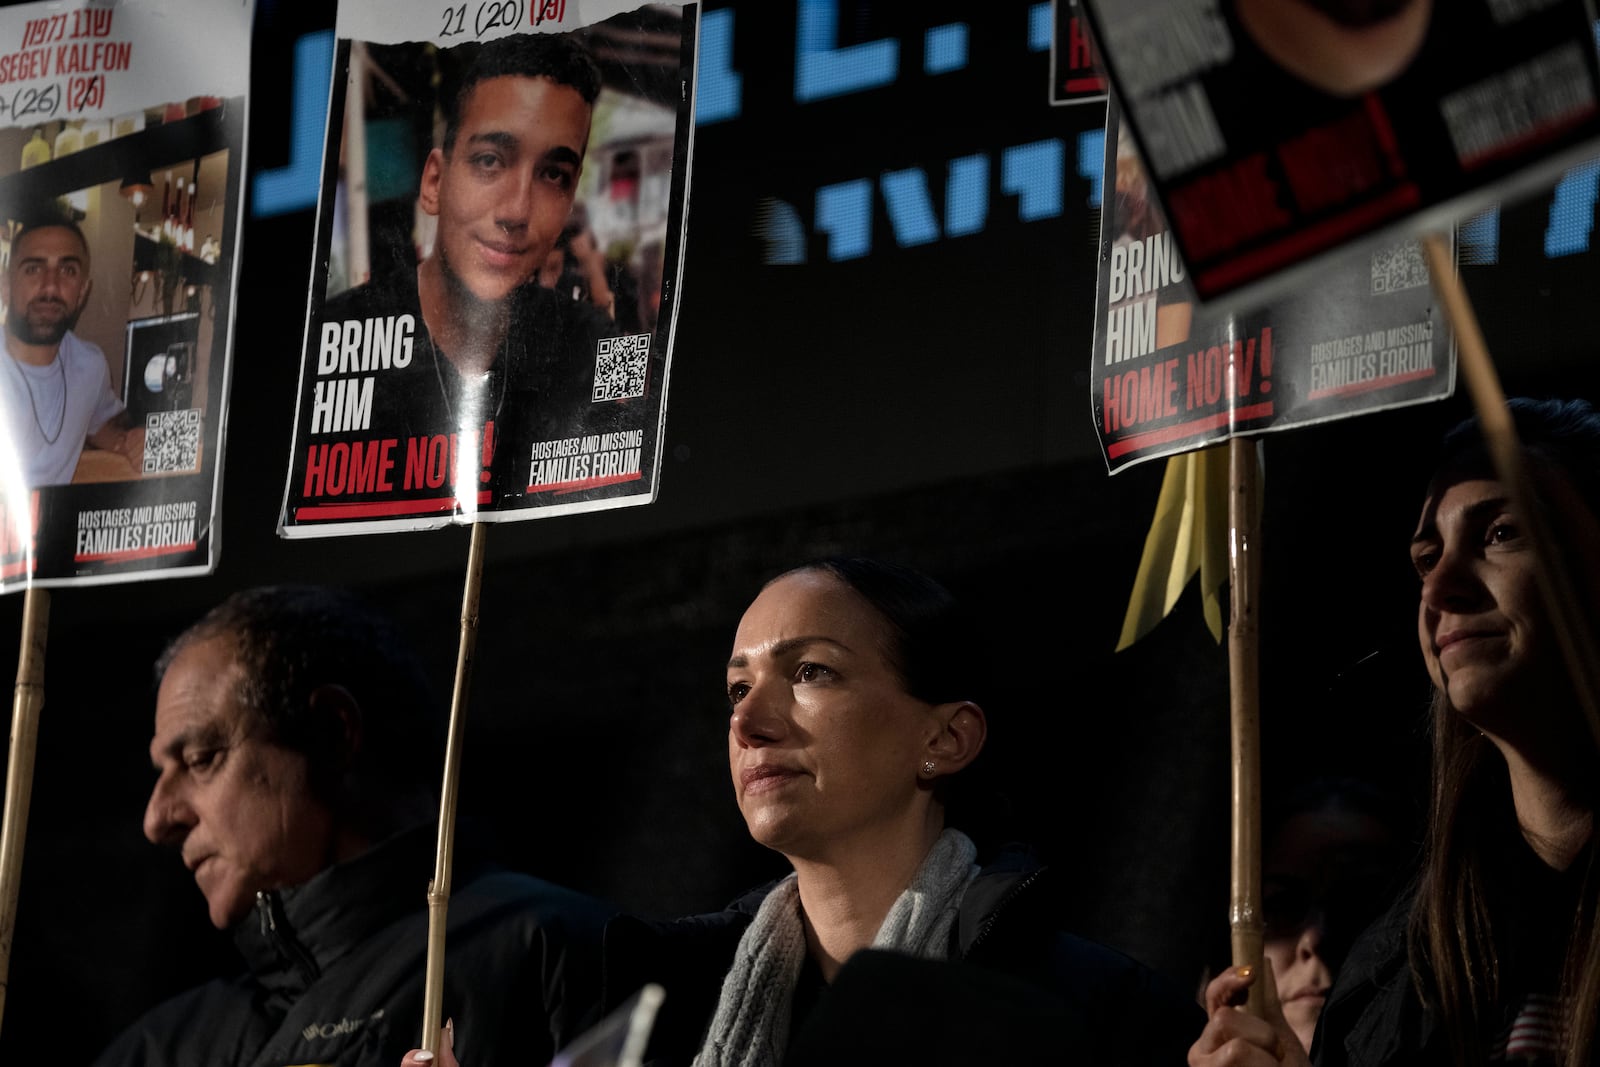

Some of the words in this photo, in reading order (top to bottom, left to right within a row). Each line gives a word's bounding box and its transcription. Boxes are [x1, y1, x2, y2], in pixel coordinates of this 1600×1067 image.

[21, 13, 68, 50] כלפון
[69, 8, 113, 39] שגב
[439, 3, 467, 37] 21
[475, 0, 524, 39] (20)
[0, 46, 51, 85] SEGEV
[55, 42, 131, 75] KALFON
[317, 313, 415, 375] BRING
[1104, 298, 1157, 366] HIM
[1311, 335, 1363, 365] HOSTAGES
[1364, 330, 1386, 353] AND
[1311, 353, 1377, 392] FAMILIES
[1379, 341, 1433, 378] FORUM
[310, 377, 375, 435] HIM
[1103, 358, 1180, 434] HOME
[531, 438, 580, 460] HOSTAGES
[579, 435, 601, 456] AND
[600, 429, 643, 452] MISSING
[303, 438, 398, 498] HOME
[528, 454, 590, 488] FAMILIES
[592, 449, 642, 479] FORUM
[77, 507, 130, 529] HOSTAGES
[132, 505, 152, 525] AND
[152, 501, 197, 522] MISSING
[76, 525, 143, 556] FAMILIES
[144, 520, 195, 549] FORUM
